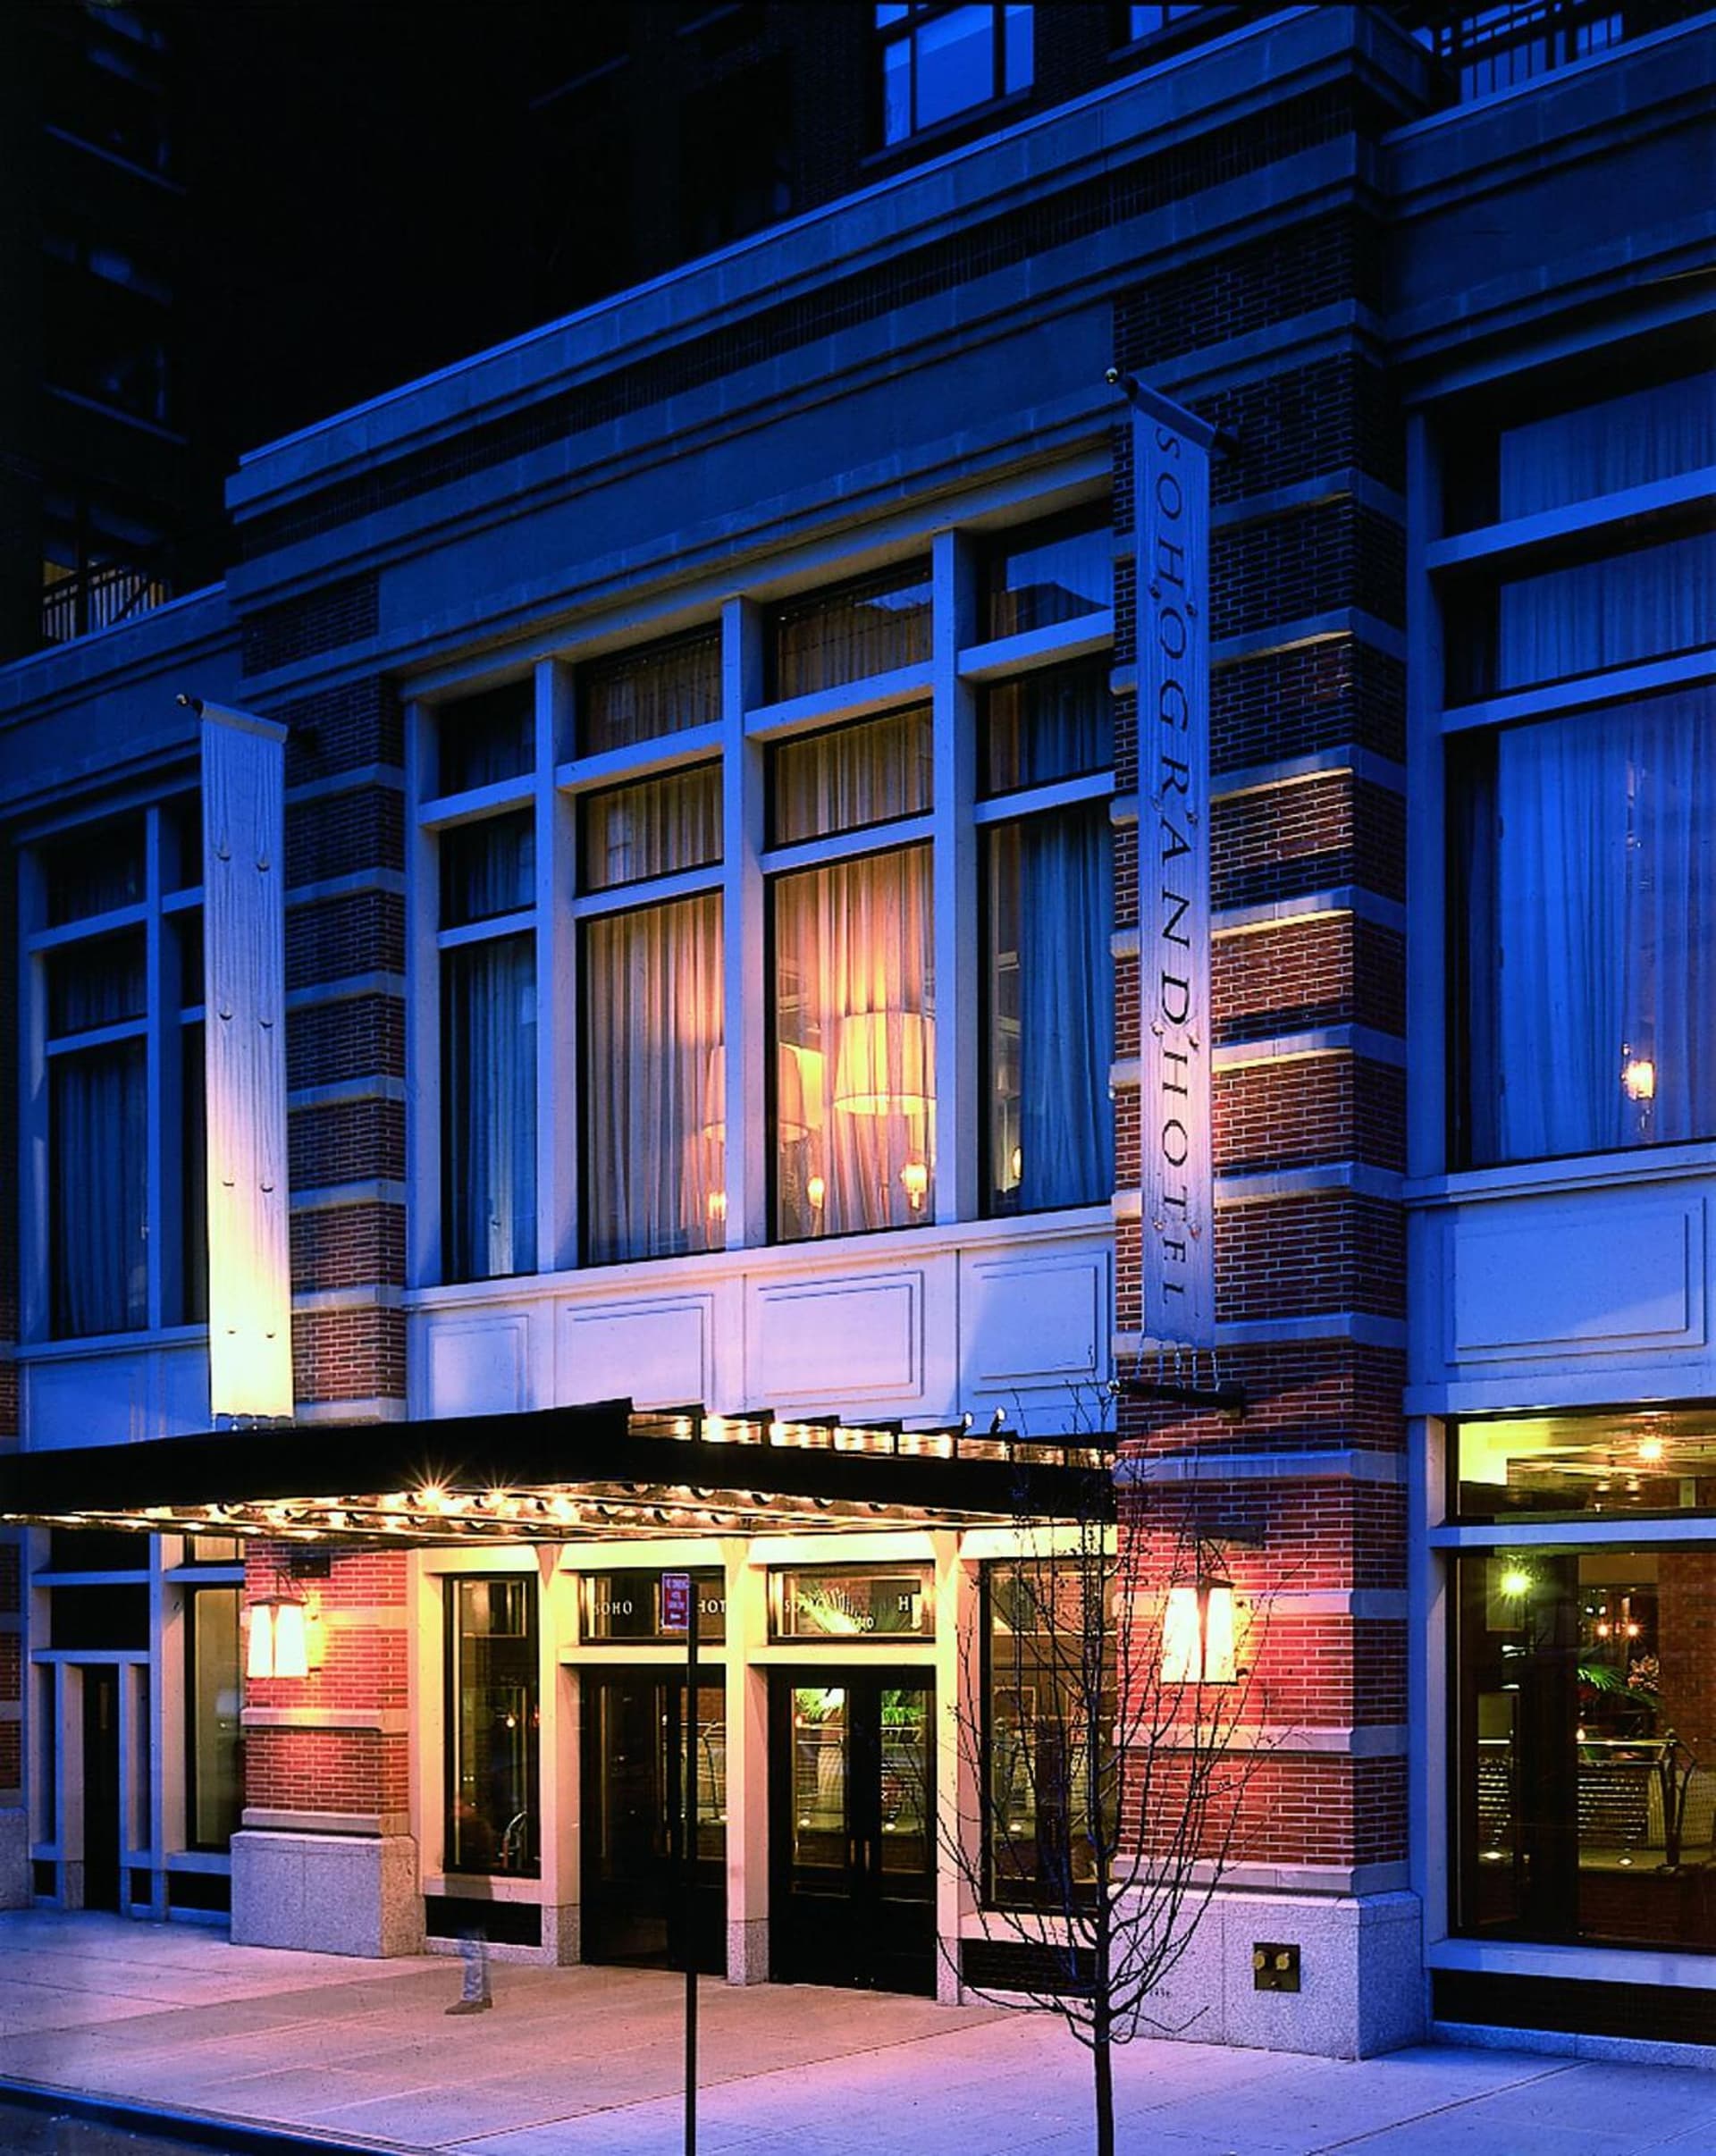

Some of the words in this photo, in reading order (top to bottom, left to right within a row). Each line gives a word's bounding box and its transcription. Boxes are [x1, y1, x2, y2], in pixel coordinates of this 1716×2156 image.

[1155, 426, 1187, 660] SOHO
[1159, 678, 1191, 1025] GRAND
[1161, 1049, 1190, 1306] HOTEL
